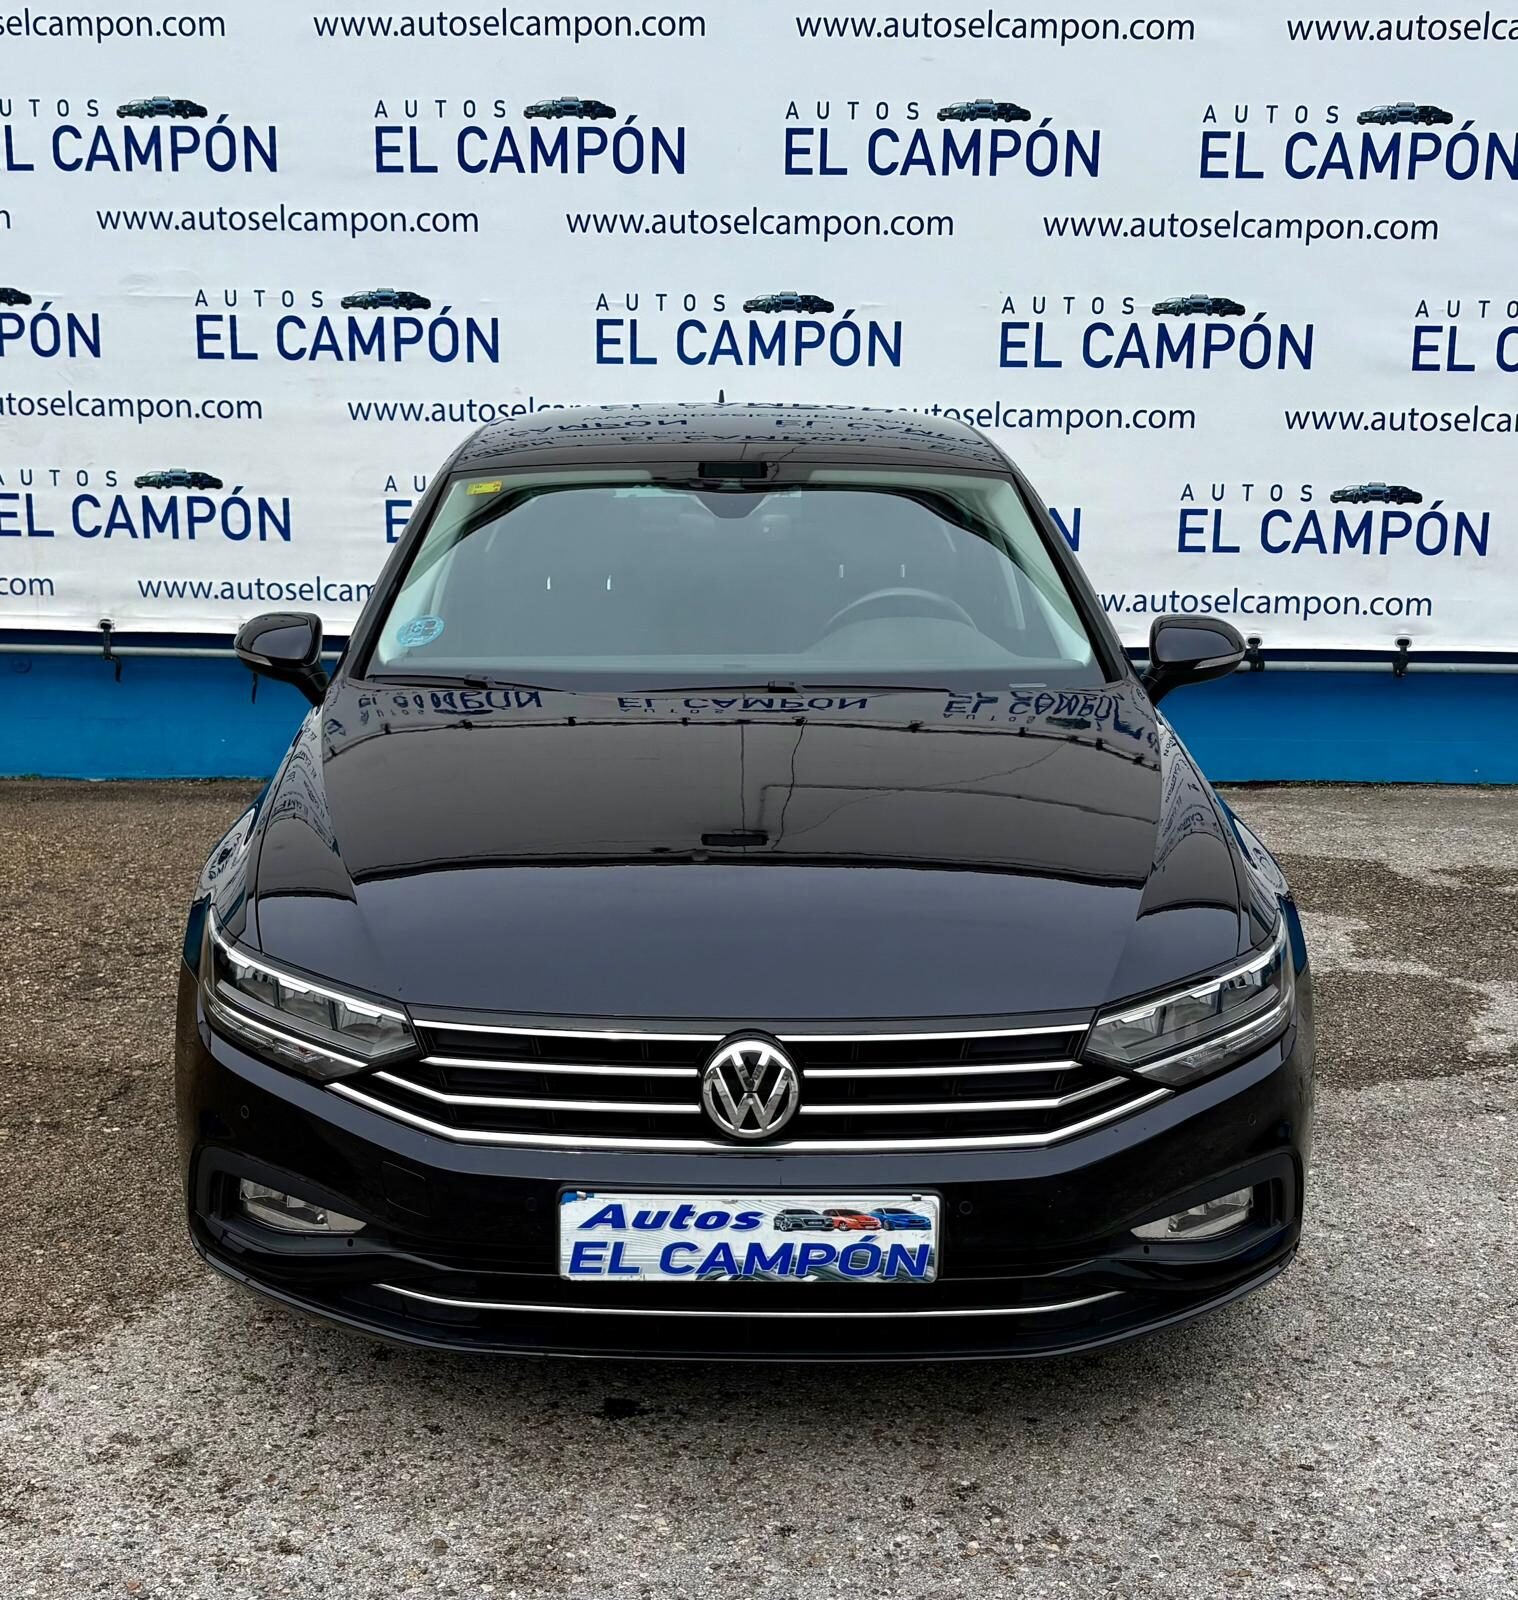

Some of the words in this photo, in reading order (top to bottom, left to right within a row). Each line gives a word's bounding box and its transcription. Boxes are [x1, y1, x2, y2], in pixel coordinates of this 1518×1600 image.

[314, 8, 705, 43] www.autoselcampon.com
[796, 9, 1194, 46] www.autoselcampon.com
[374, 100, 505, 118] AUTOS
[785, 101, 919, 120] AUTOS
[1203, 105, 1338, 124] AUTOS
[53, 114, 277, 172] CAMPÓN
[375, 126, 438, 173] EL
[457, 115, 685, 174] CAMPÓN
[785, 128, 847, 175] EL
[868, 117, 1100, 177] CAMPÓN
[1200, 131, 1264, 179] EL
[1285, 120, 1518, 180] CAMPÓN
[97, 204, 478, 239] www.autoselcampon.com
[566, 207, 953, 242] www.autoselcampon.com
[1043, 210, 1438, 246] www.autoselcampon.com
[195, 289, 323, 308] AUTOS
[596, 293, 725, 312] AUTOS
[1001, 296, 1134, 315] AUTOS
[196, 314, 258, 360] EL
[277, 306, 499, 363] CAMPÓN
[596, 319, 657, 365] EL
[677, 309, 902, 367] CAMPÓN
[1000, 322, 1062, 368] EL
[1083, 312, 1313, 370] CAMPÓN
[1412, 325, 1475, 372] EL
[1285, 405, 1518, 433] www.autoselca
[1180, 484, 1312, 502] AUTOS
[0, 493, 54, 537] EL
[72, 486, 291, 541] CAMPÓN
[1178, 509, 1240, 553] EL
[1261, 500, 1489, 556] CAMPÓN
[577, 1203, 765, 1231] Autos
[568, 1241, 640, 1274] EL
[659, 1235, 930, 1277] CAMPÓN
